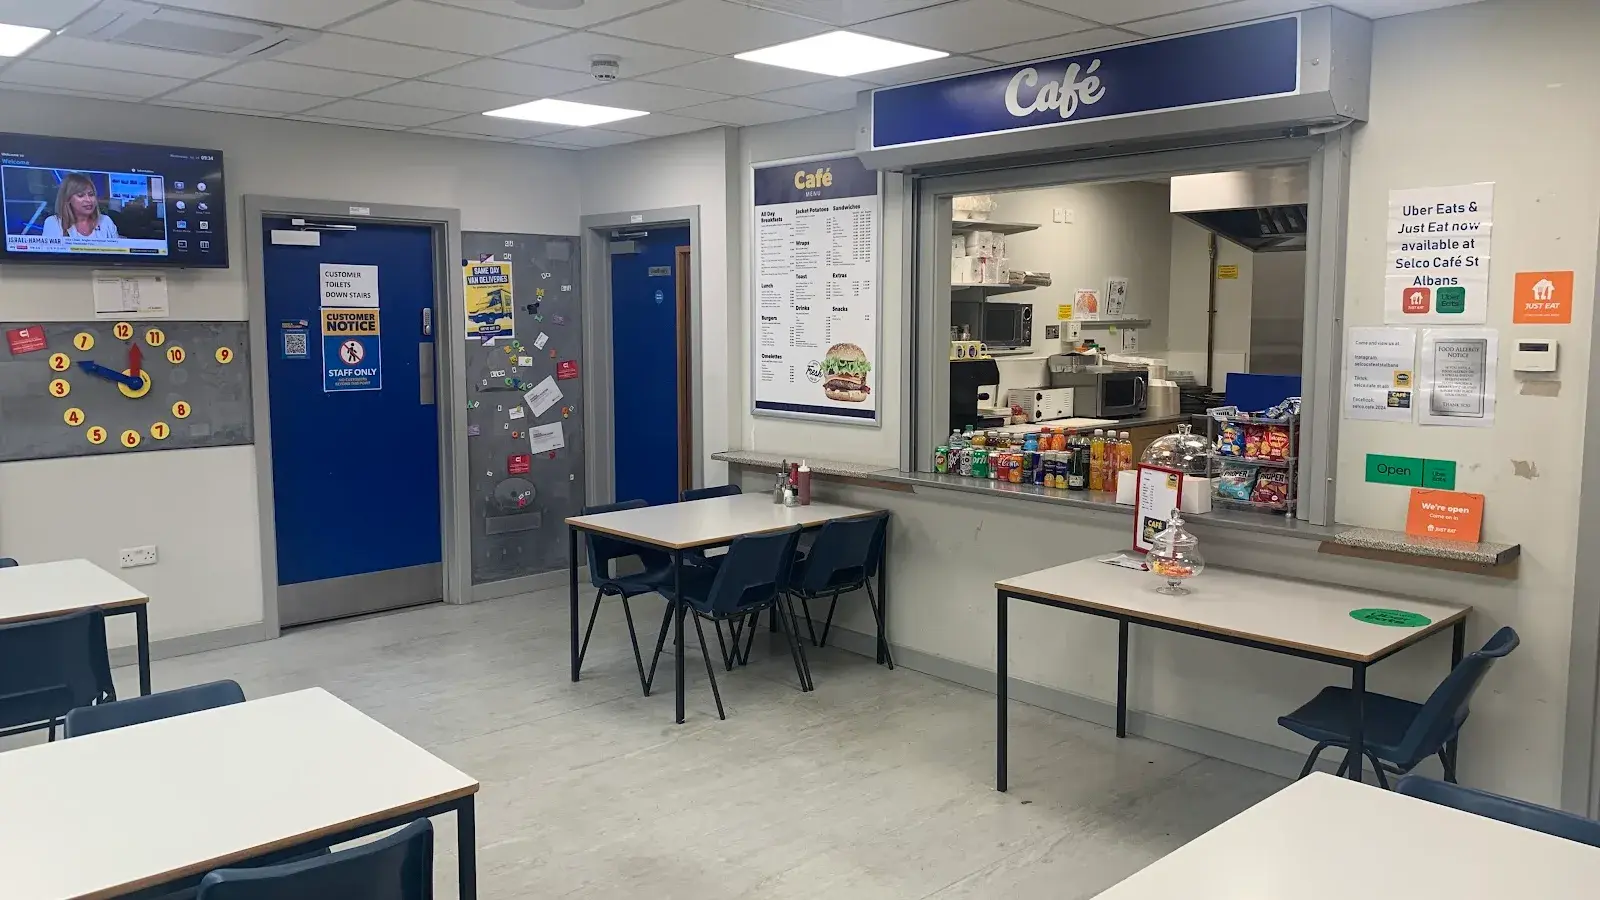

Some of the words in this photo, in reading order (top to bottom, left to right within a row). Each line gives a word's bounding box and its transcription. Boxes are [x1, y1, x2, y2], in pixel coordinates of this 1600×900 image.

[1004, 58, 1105, 118] Café
[794, 167, 833, 190] Café
[1402, 204, 1433, 217] Uber
[1436, 203, 1465, 214] Eats
[1468, 201, 1478, 212] &
[1397, 222, 1425, 234] Just
[1428, 221, 1449, 233] Eat
[1451, 221, 1481, 231] now
[1401, 238, 1459, 252] available
[1462, 238, 1475, 249] at
[1395, 257, 1430, 269] Selco
[1433, 255, 1462, 268] Café
[1465, 256, 1479, 267] St
[480, 276, 508, 284] DELIVERIES
[1413, 275, 1458, 286] Albans
[1524, 302, 1544, 310] JUST
[326, 313, 376, 321] CUSTOMER
[117, 325, 128, 336] 12
[326, 320, 376, 332] NOTICE
[80, 336, 86, 348] 1
[150, 332, 160, 344] 11
[170, 349, 181, 361] 10
[221, 350, 228, 360] 9
[55, 356, 64, 368] 2
[328, 369, 353, 377] STAFF
[354, 368, 377, 376] ONLY
[55, 382, 64, 394] 3
[178, 404, 185, 416] 8
[69, 411, 78, 424] 4
[93, 430, 101, 441] 5
[156, 424, 164, 438] 7
[127, 432, 135, 444] 6
[1377, 462, 1411, 477] Open
[1422, 501, 1446, 512] We're
[1448, 505, 1470, 514] open
[1148, 519, 1163, 530] CAFÉ
